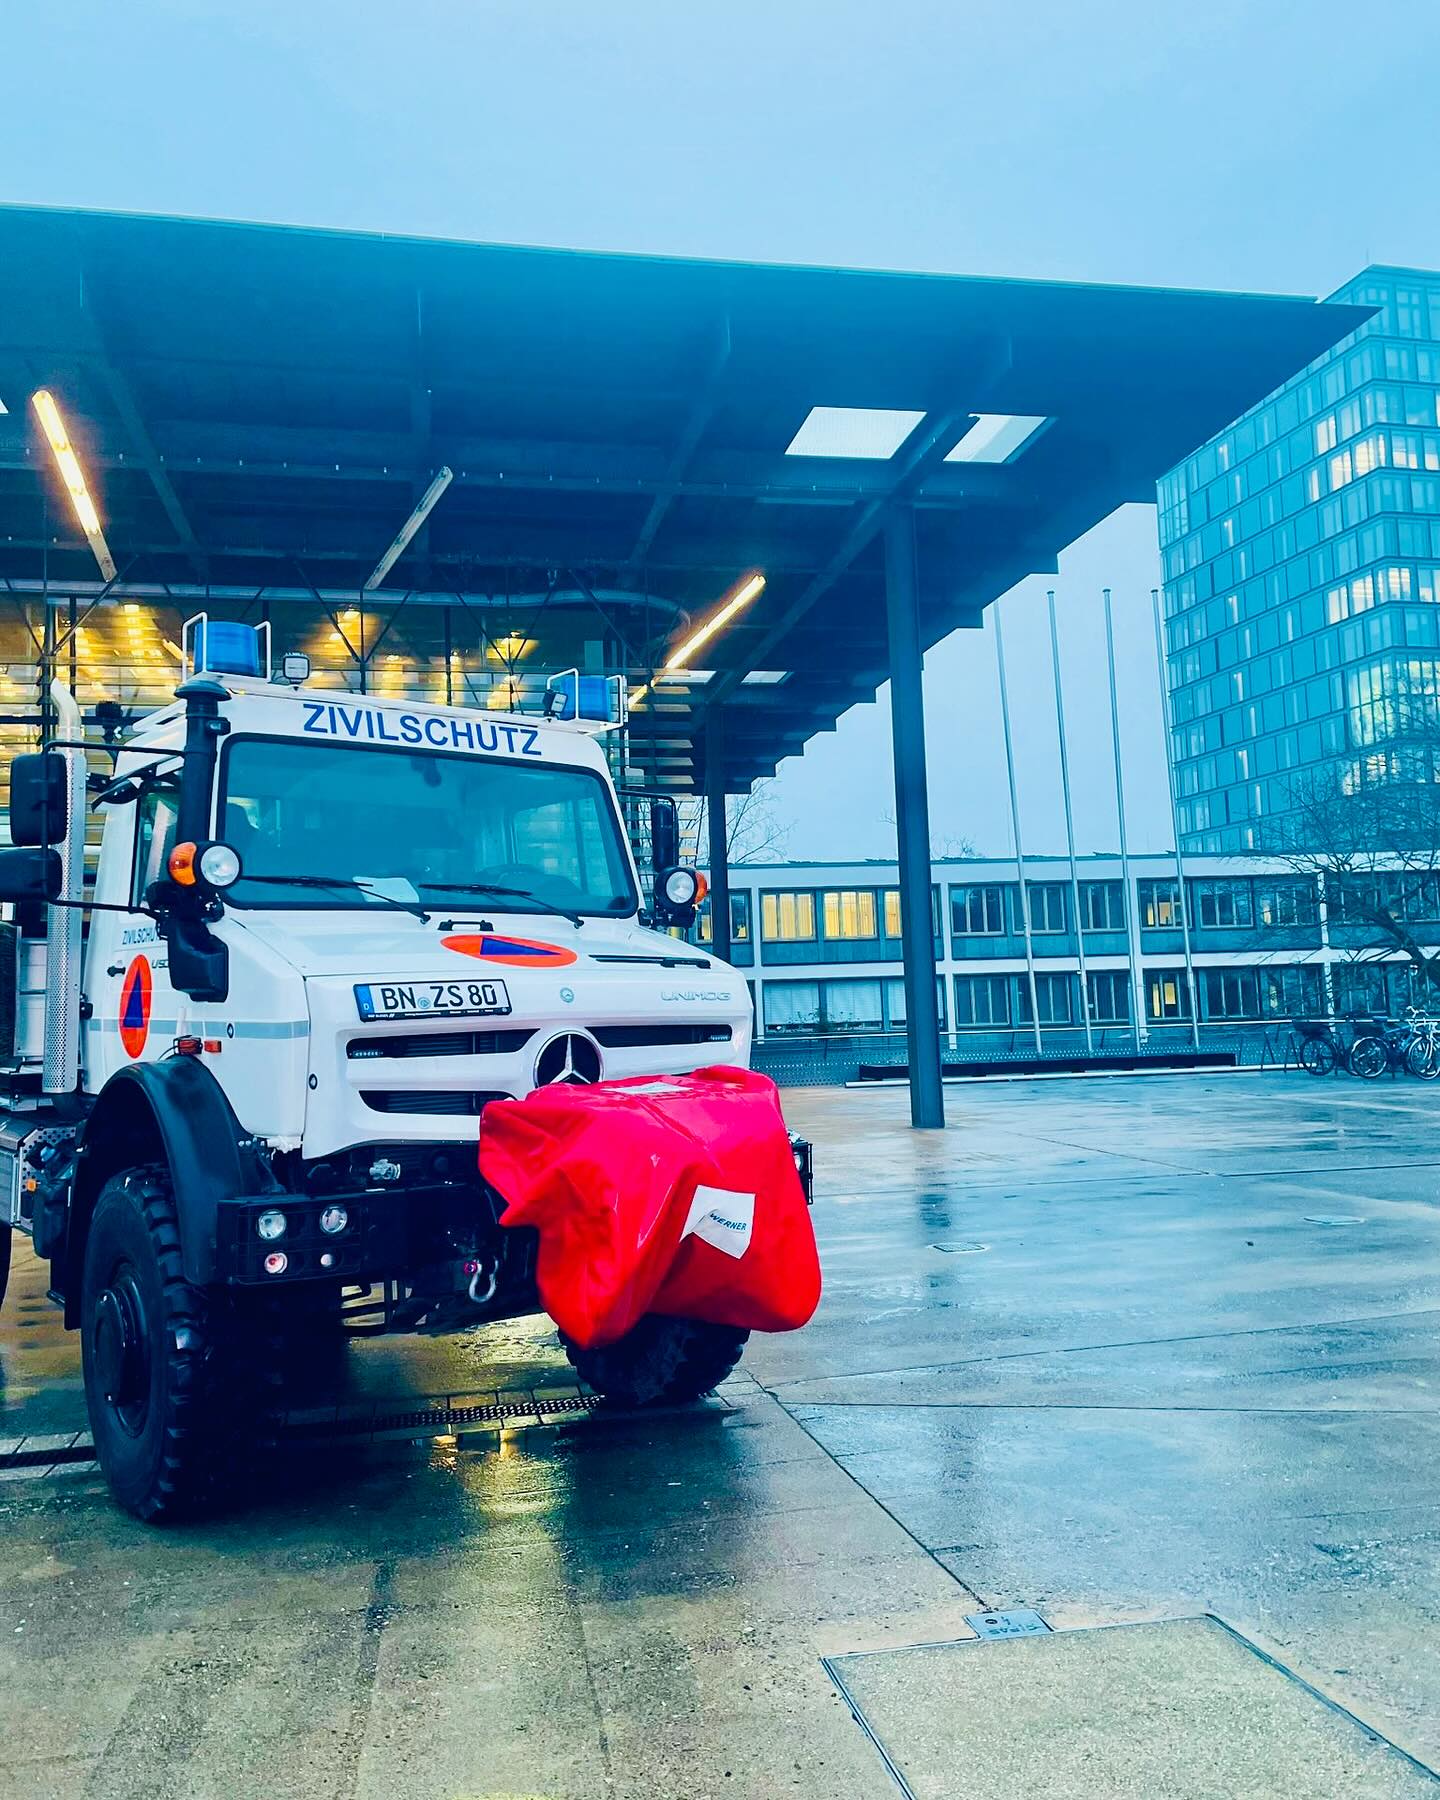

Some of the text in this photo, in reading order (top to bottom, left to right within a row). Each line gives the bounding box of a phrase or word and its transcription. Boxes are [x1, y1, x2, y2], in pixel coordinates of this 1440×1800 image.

[302, 703, 542, 755] ZIVILSCHUTZ
[380, 987, 417, 1010] BN
[429, 985, 463, 1008] ZS
[467, 984, 498, 1006] 80
[661, 991, 731, 1001] UNIMOG
[709, 1212, 747, 1231] WERNER
